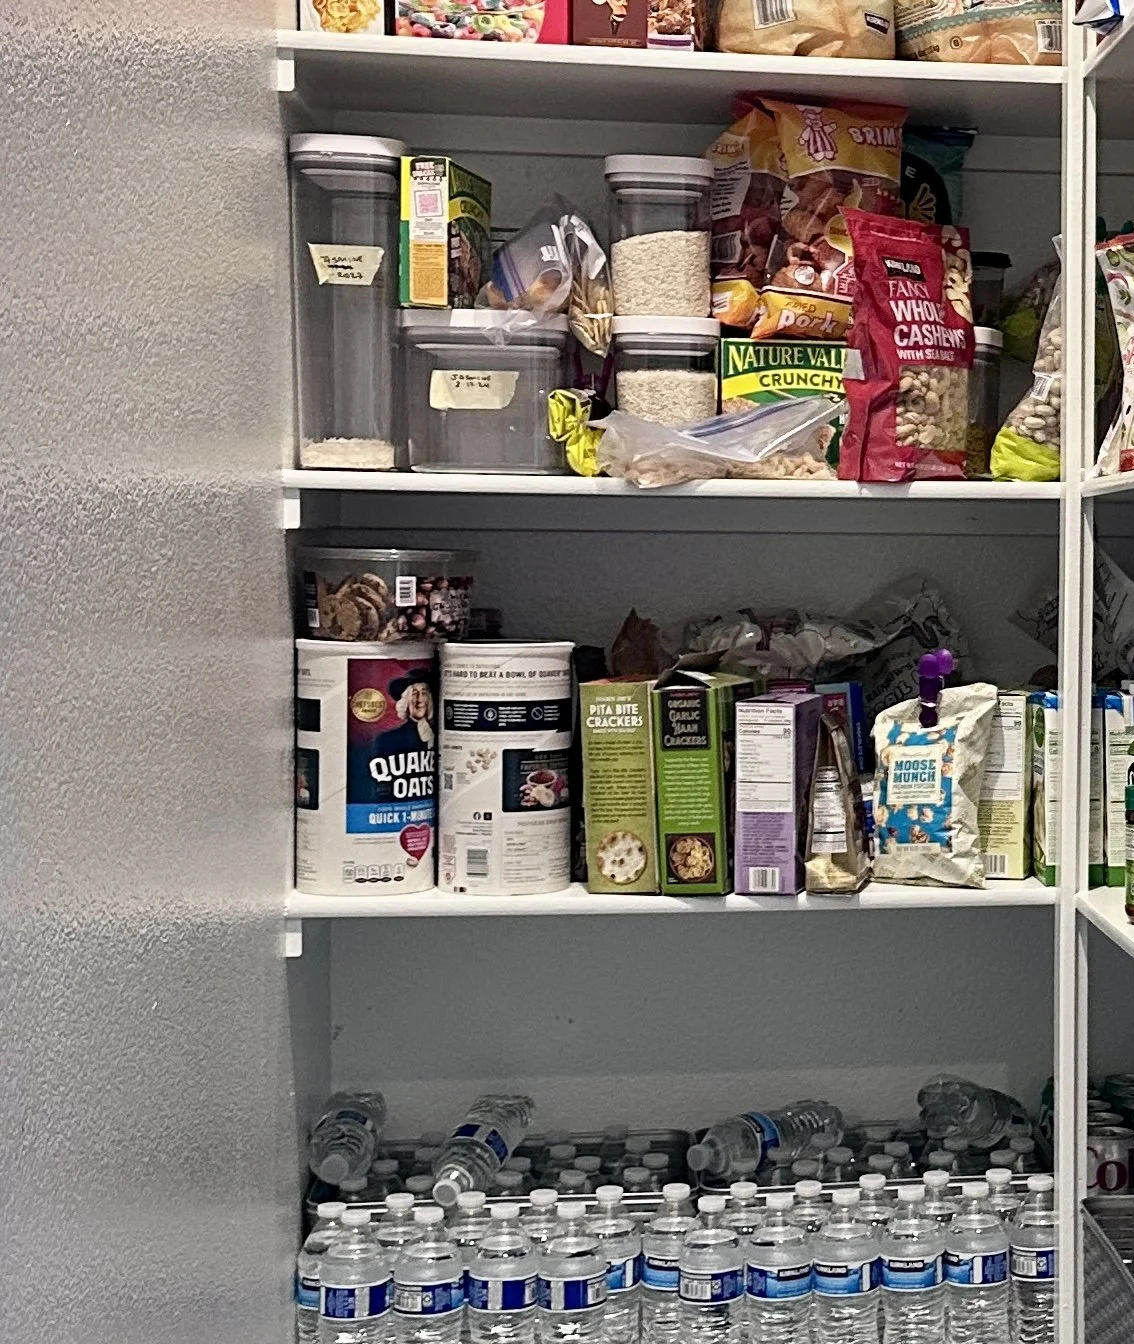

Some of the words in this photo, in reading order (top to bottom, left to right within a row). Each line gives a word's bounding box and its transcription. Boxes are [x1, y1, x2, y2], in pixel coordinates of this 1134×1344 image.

[887, 281, 930, 298] FANCY
[890, 301, 945, 323] WHOLE
[778, 309, 837, 332] pork
[894, 325, 966, 349] CASHEWS
[728, 347, 805, 373] NATURE
[897, 349, 924, 360] WITH
[758, 374, 843, 389] CRUNCHY
[590, 705, 612, 715] PITA
[616, 704, 638, 715] BITE
[669, 710, 700, 721] GARLIC
[586, 716, 643, 728] CRACKERS
[664, 735, 706, 746] CRACKERS
[894, 760, 936, 771] MOOSE
[894, 772, 935, 783] MUNCH
[393, 777, 434, 799] OATS
[369, 812, 400, 824] QUICK
